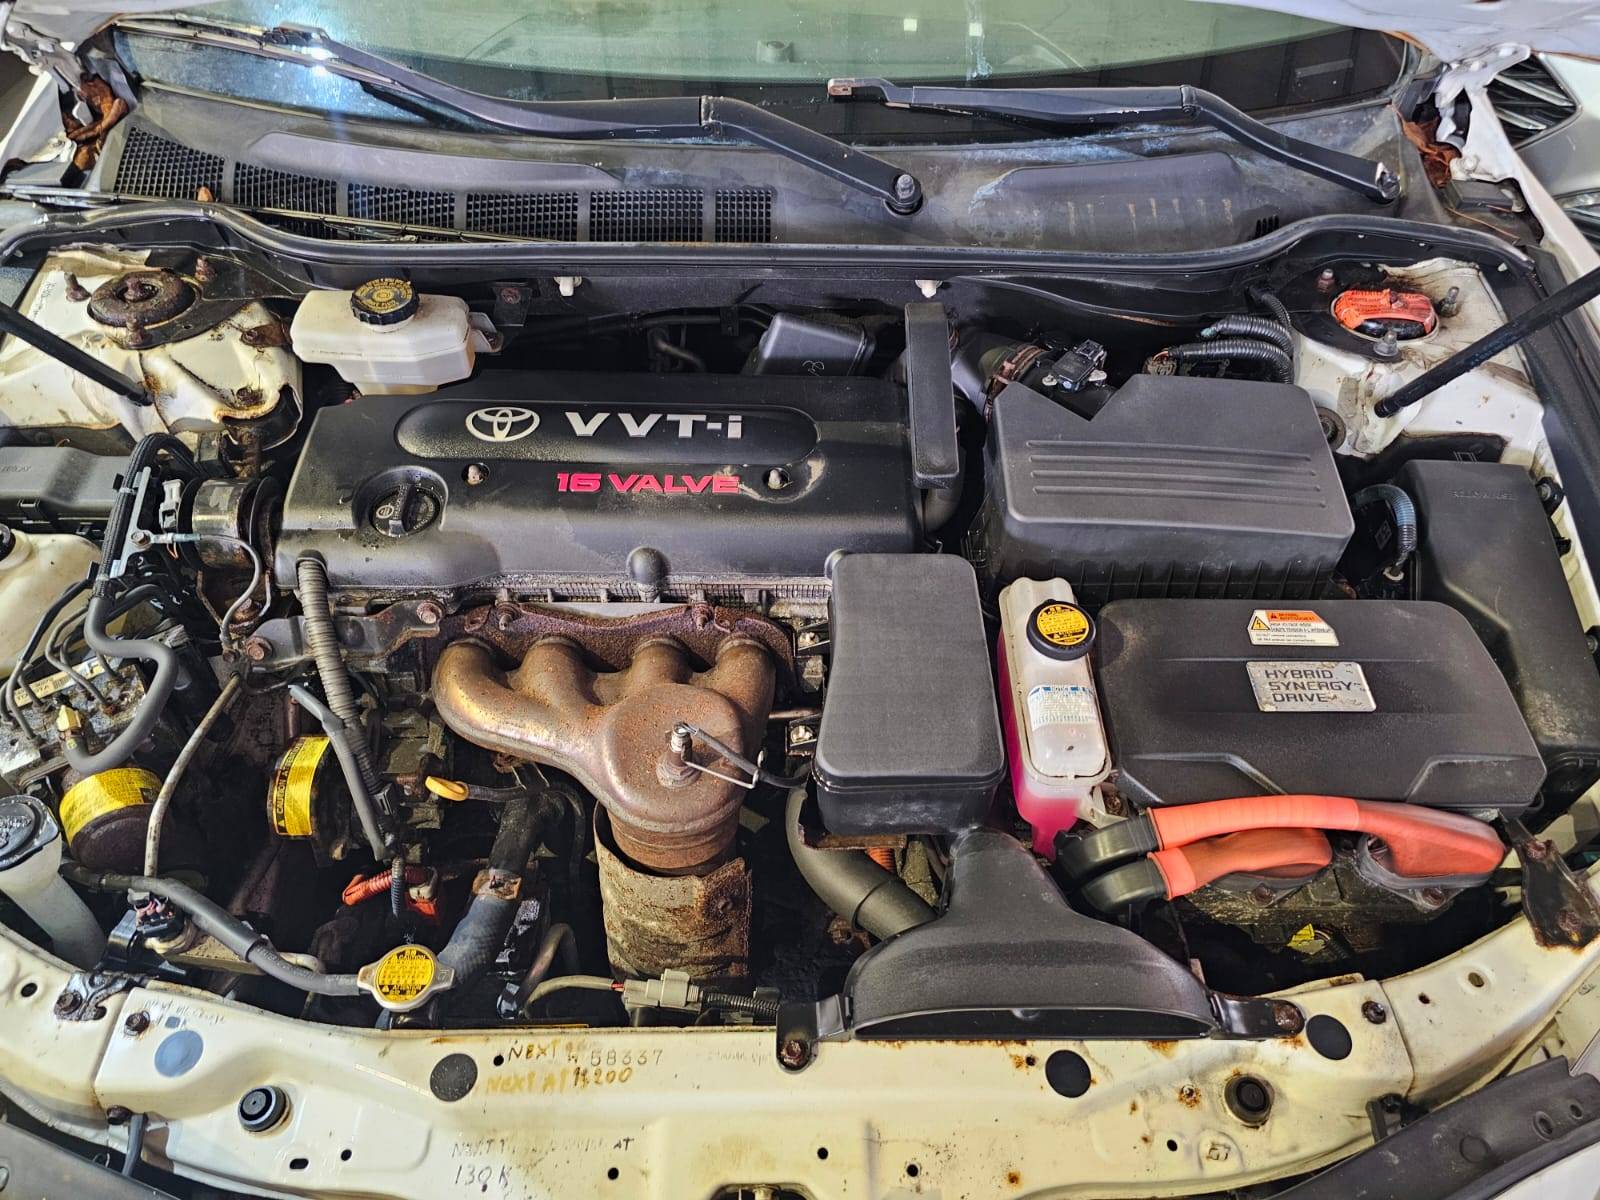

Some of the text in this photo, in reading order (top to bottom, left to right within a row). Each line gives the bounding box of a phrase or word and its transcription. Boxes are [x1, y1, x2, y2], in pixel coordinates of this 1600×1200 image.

[565, 411, 742, 439] VVT-i
[557, 472, 740, 495] 16 VALVE
[1265, 670, 1334, 679] HYBRID
[1269, 681, 1353, 692] SYNERGY
[1272, 693, 1329, 703] DRIVE
[276, 780, 287, 814] CAUTION
